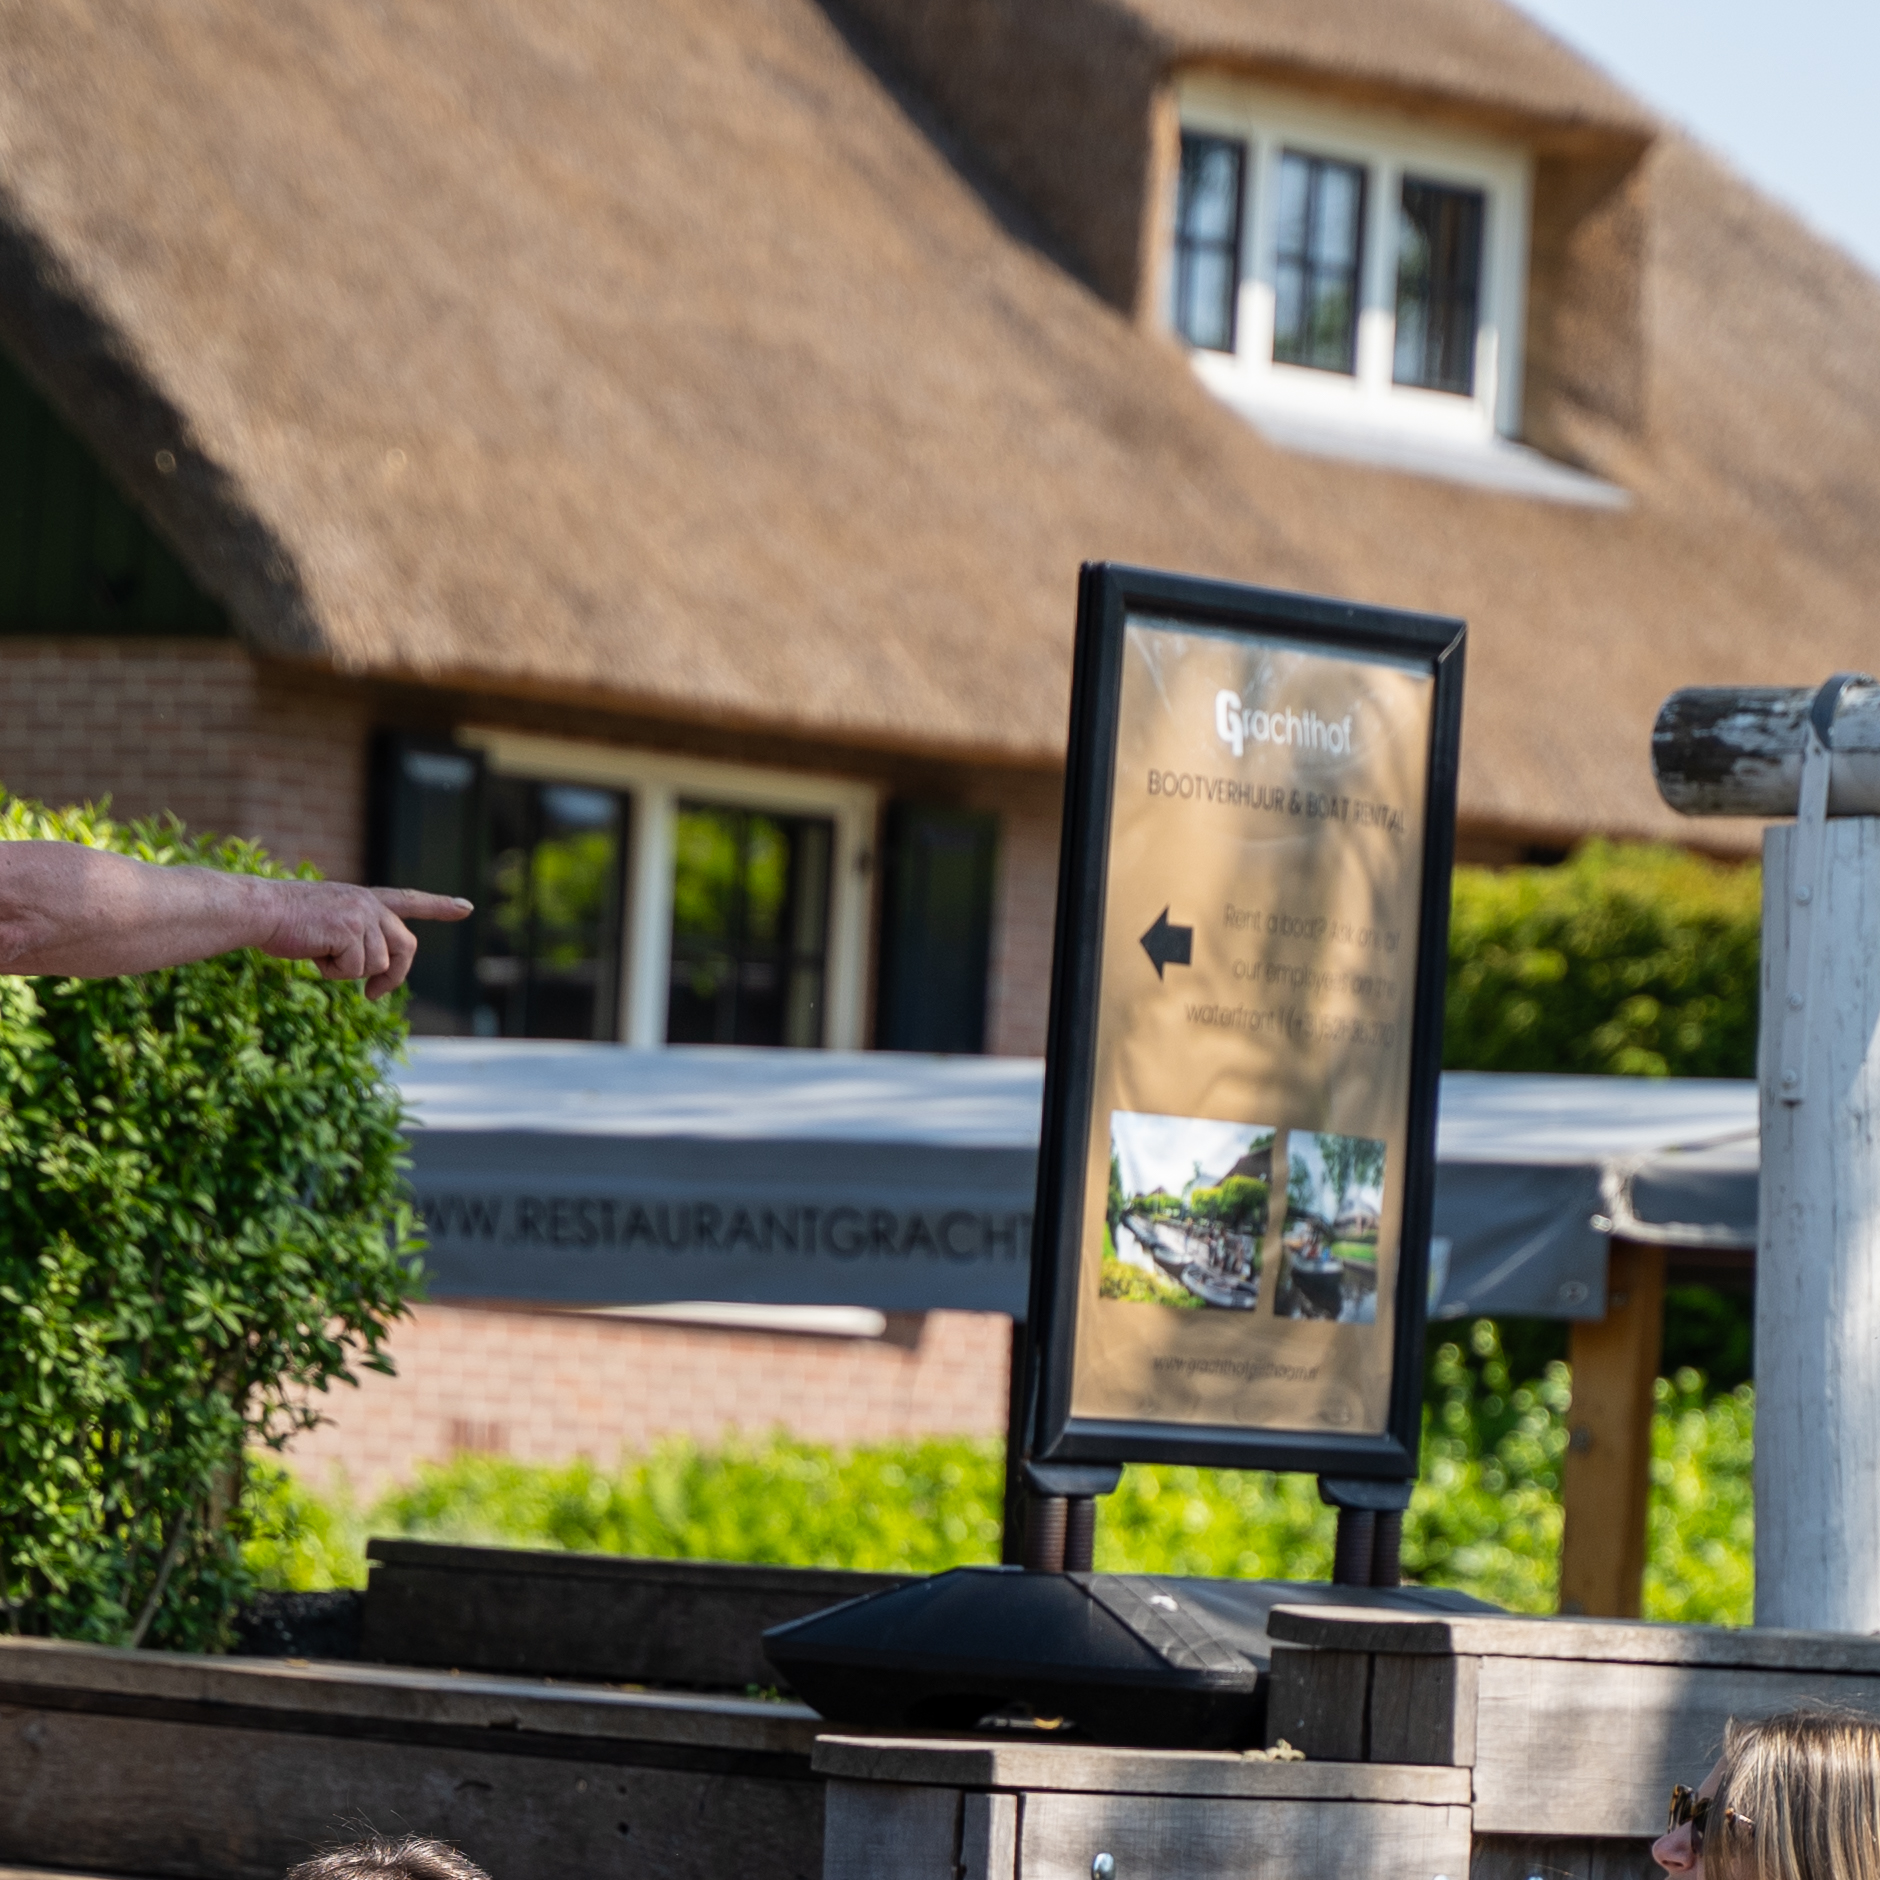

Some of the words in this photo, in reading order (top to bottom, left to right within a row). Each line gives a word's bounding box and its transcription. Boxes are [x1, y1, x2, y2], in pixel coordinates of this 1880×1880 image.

[1216, 689, 1352, 757] Grachthof
[1147, 769, 1285, 813] BOOTVERHUUR
[1288, 789, 1301, 816] &
[1305, 791, 1350, 822] BOAT
[1352, 798, 1405, 834] RENTAL
[1224, 903, 1262, 932] Rent
